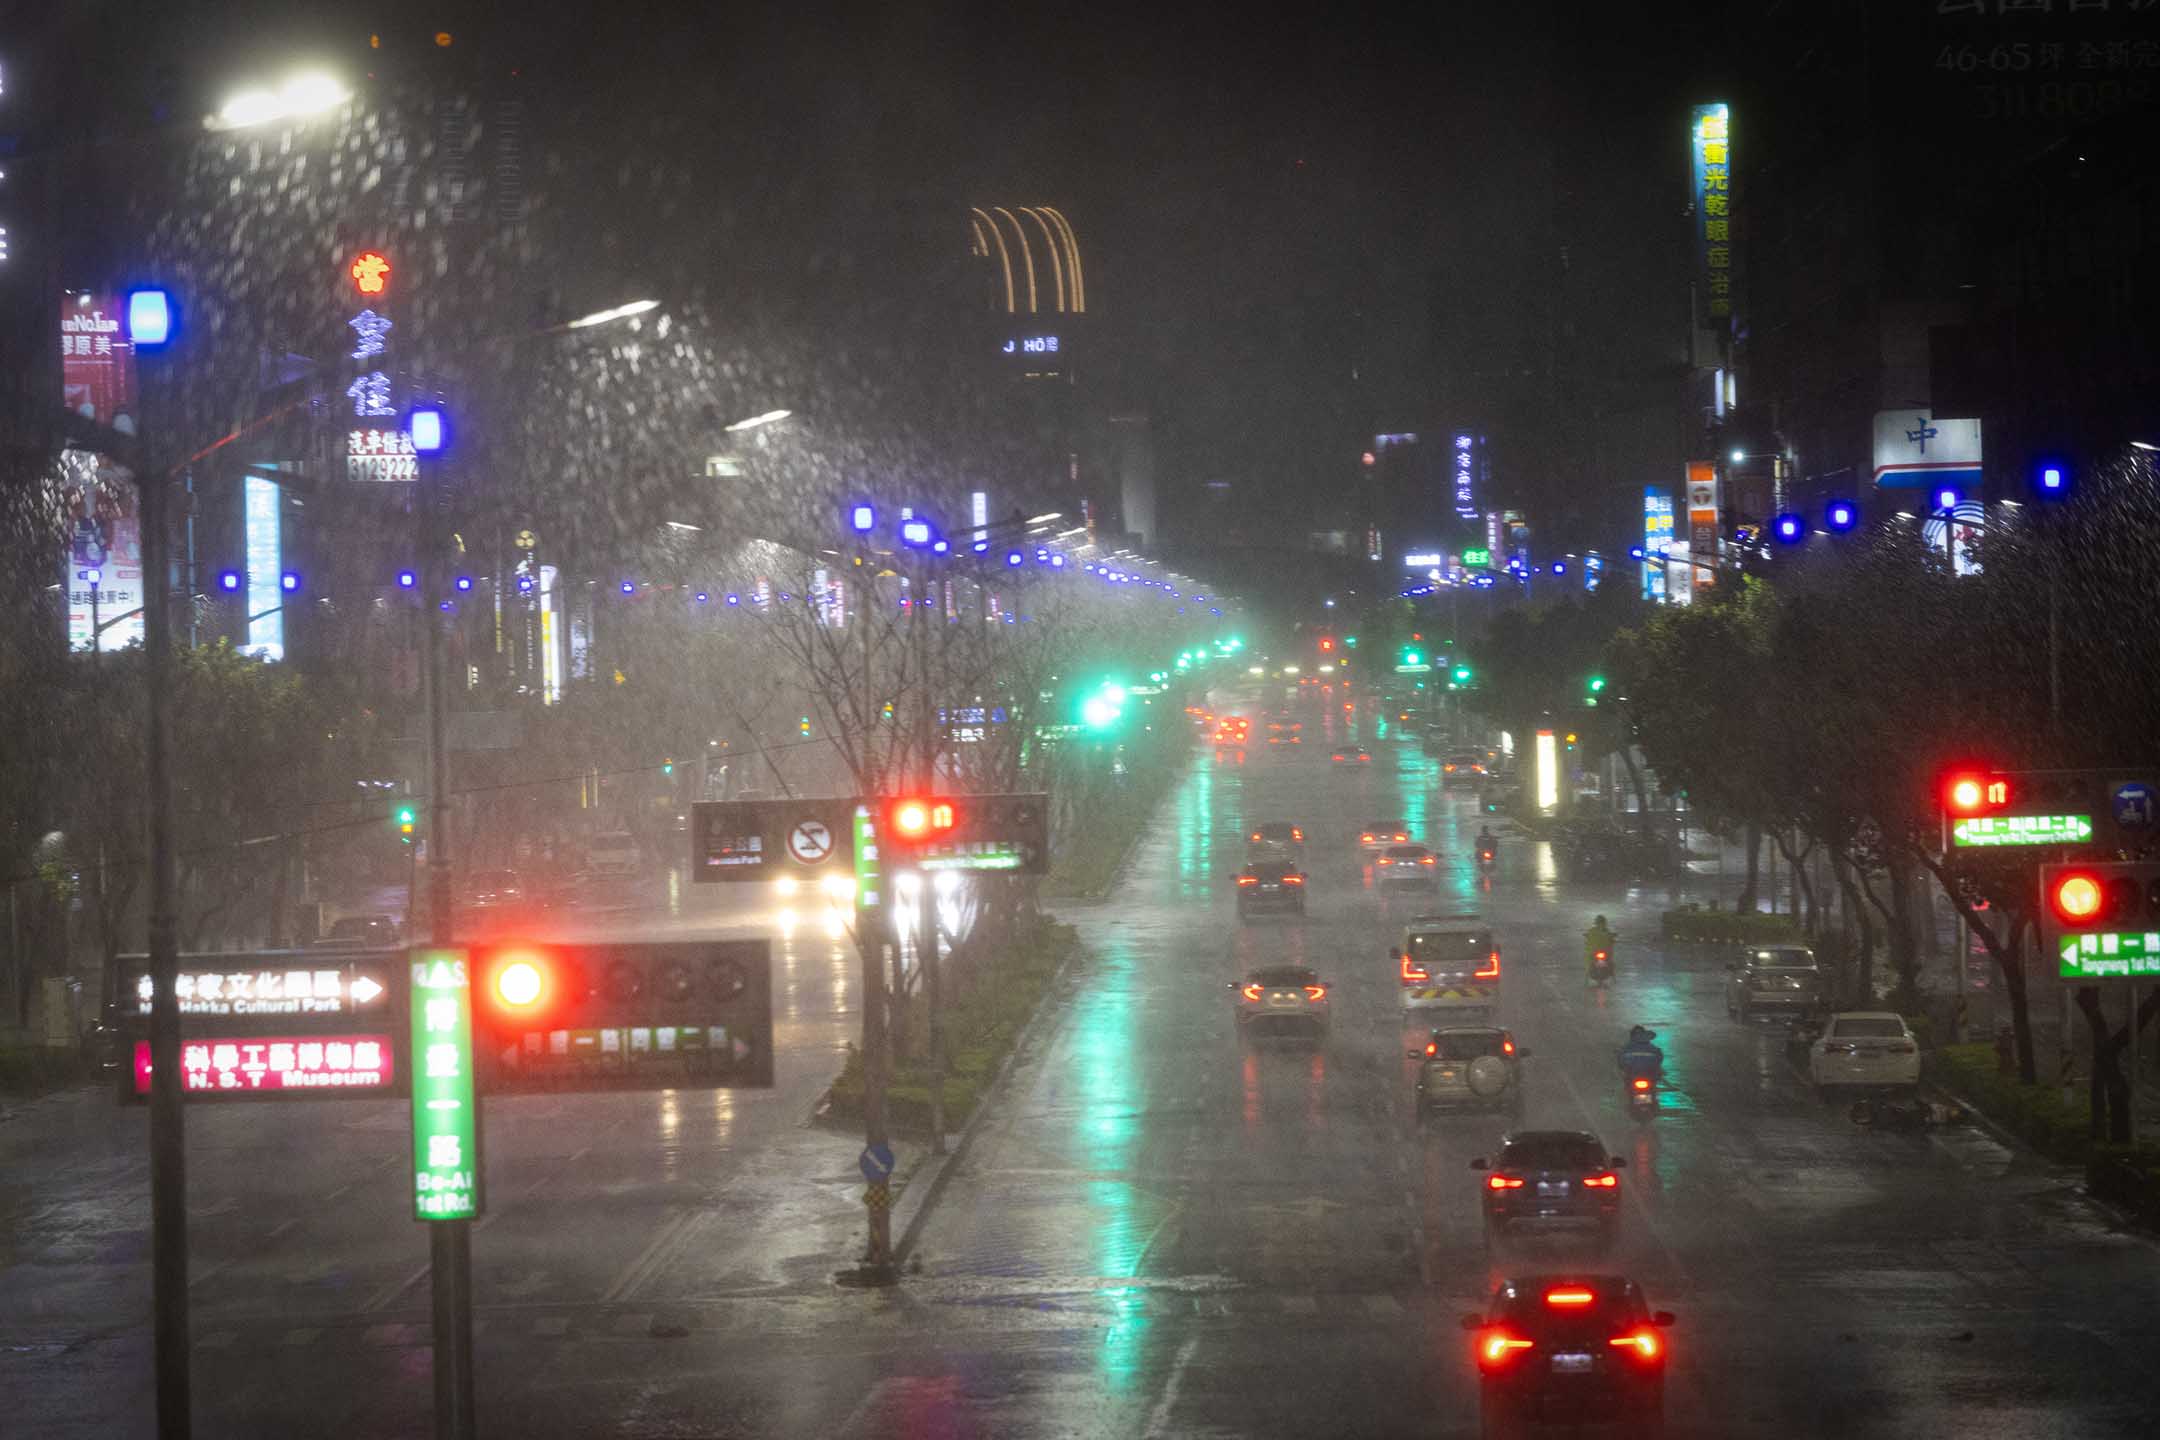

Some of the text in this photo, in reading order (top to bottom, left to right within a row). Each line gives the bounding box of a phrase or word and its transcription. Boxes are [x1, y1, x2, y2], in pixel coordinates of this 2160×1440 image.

[1905, 416, 1938, 455] 中
[179, 998, 341, 1014] Hakka Cultural Park
[282, 1070, 381, 1087] Museum
[416, 1172, 472, 1191] Bo-Ai
